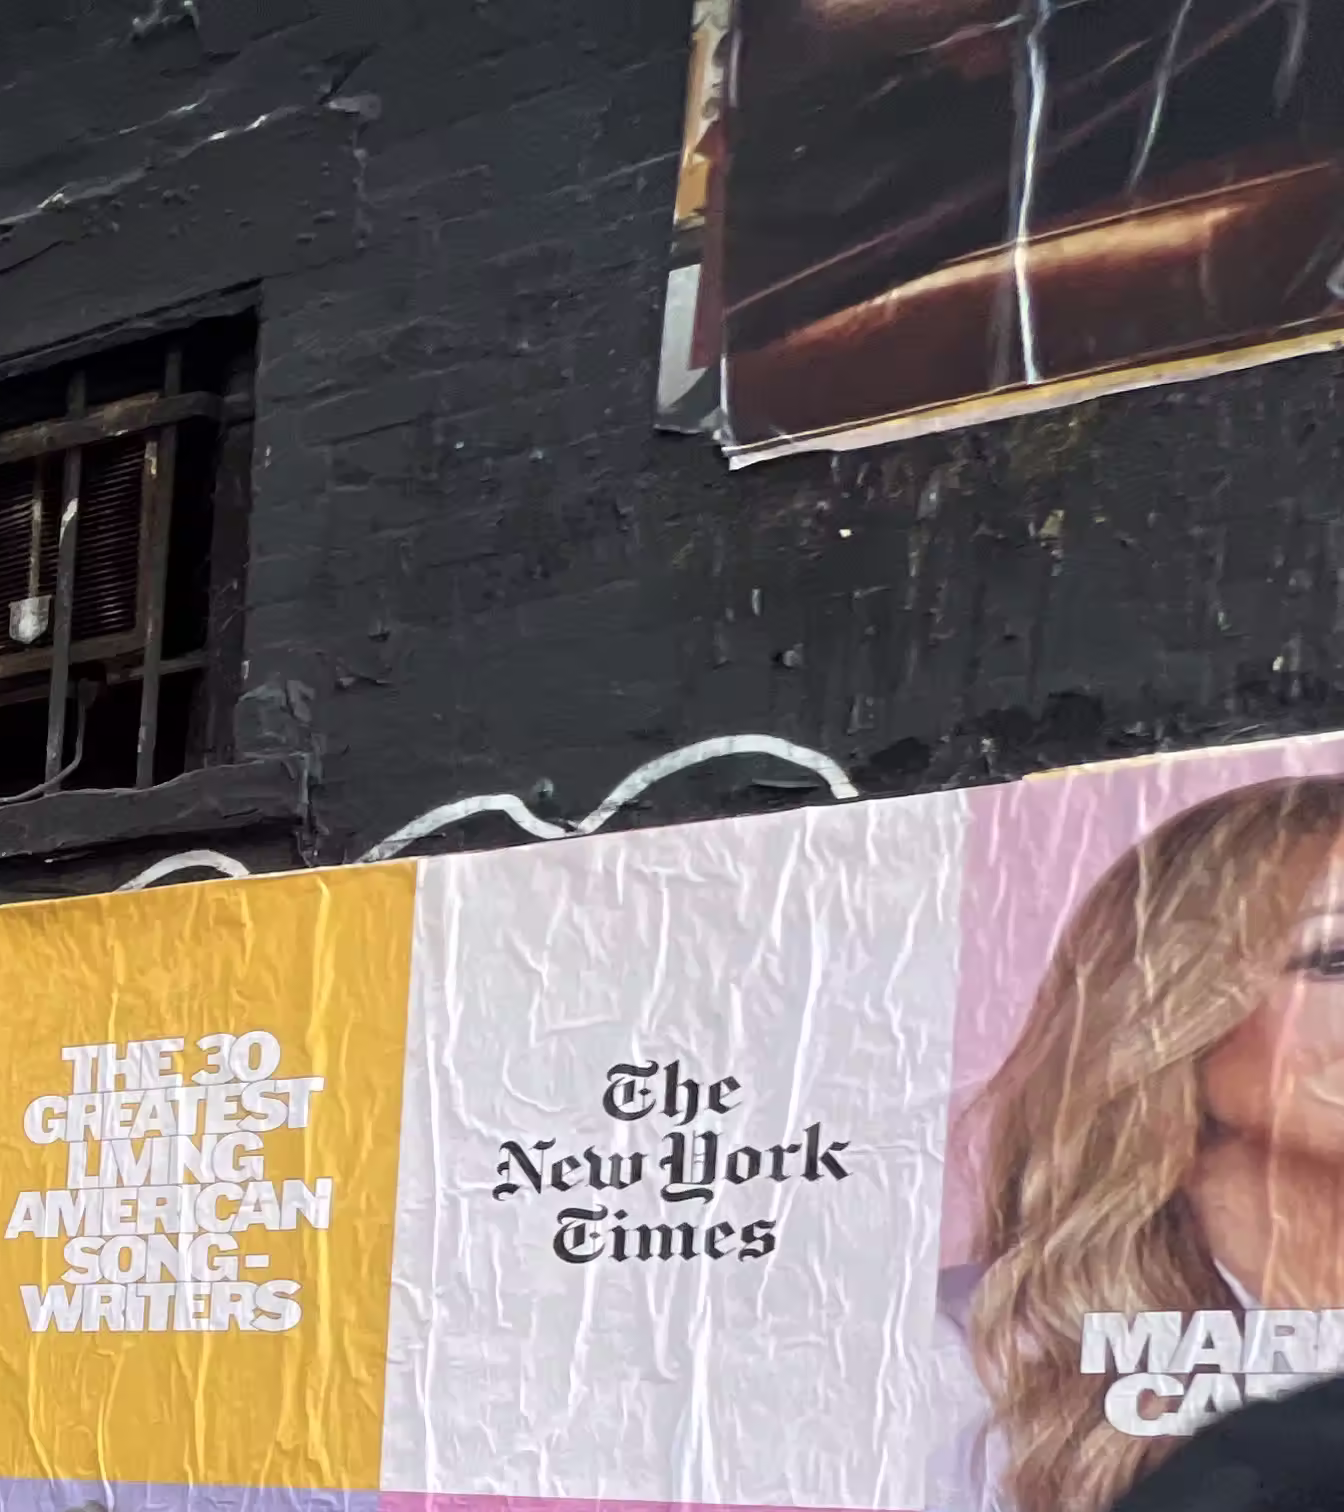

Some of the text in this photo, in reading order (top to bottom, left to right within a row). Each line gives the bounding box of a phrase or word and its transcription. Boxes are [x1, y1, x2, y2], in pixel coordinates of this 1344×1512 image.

[62, 1030, 281, 1095] THE 30
[602, 1059, 742, 1126] The
[23, 1077, 324, 1144] GREATEST
[67, 1132, 265, 1189] LIVING
[492, 1122, 852, 1203] New York
[4, 1177, 333, 1239] AMERICAN
[553, 1204, 776, 1264] Times
[61, 1232, 270, 1285] SONG-
[19, 1279, 303, 1333] WRITERS
